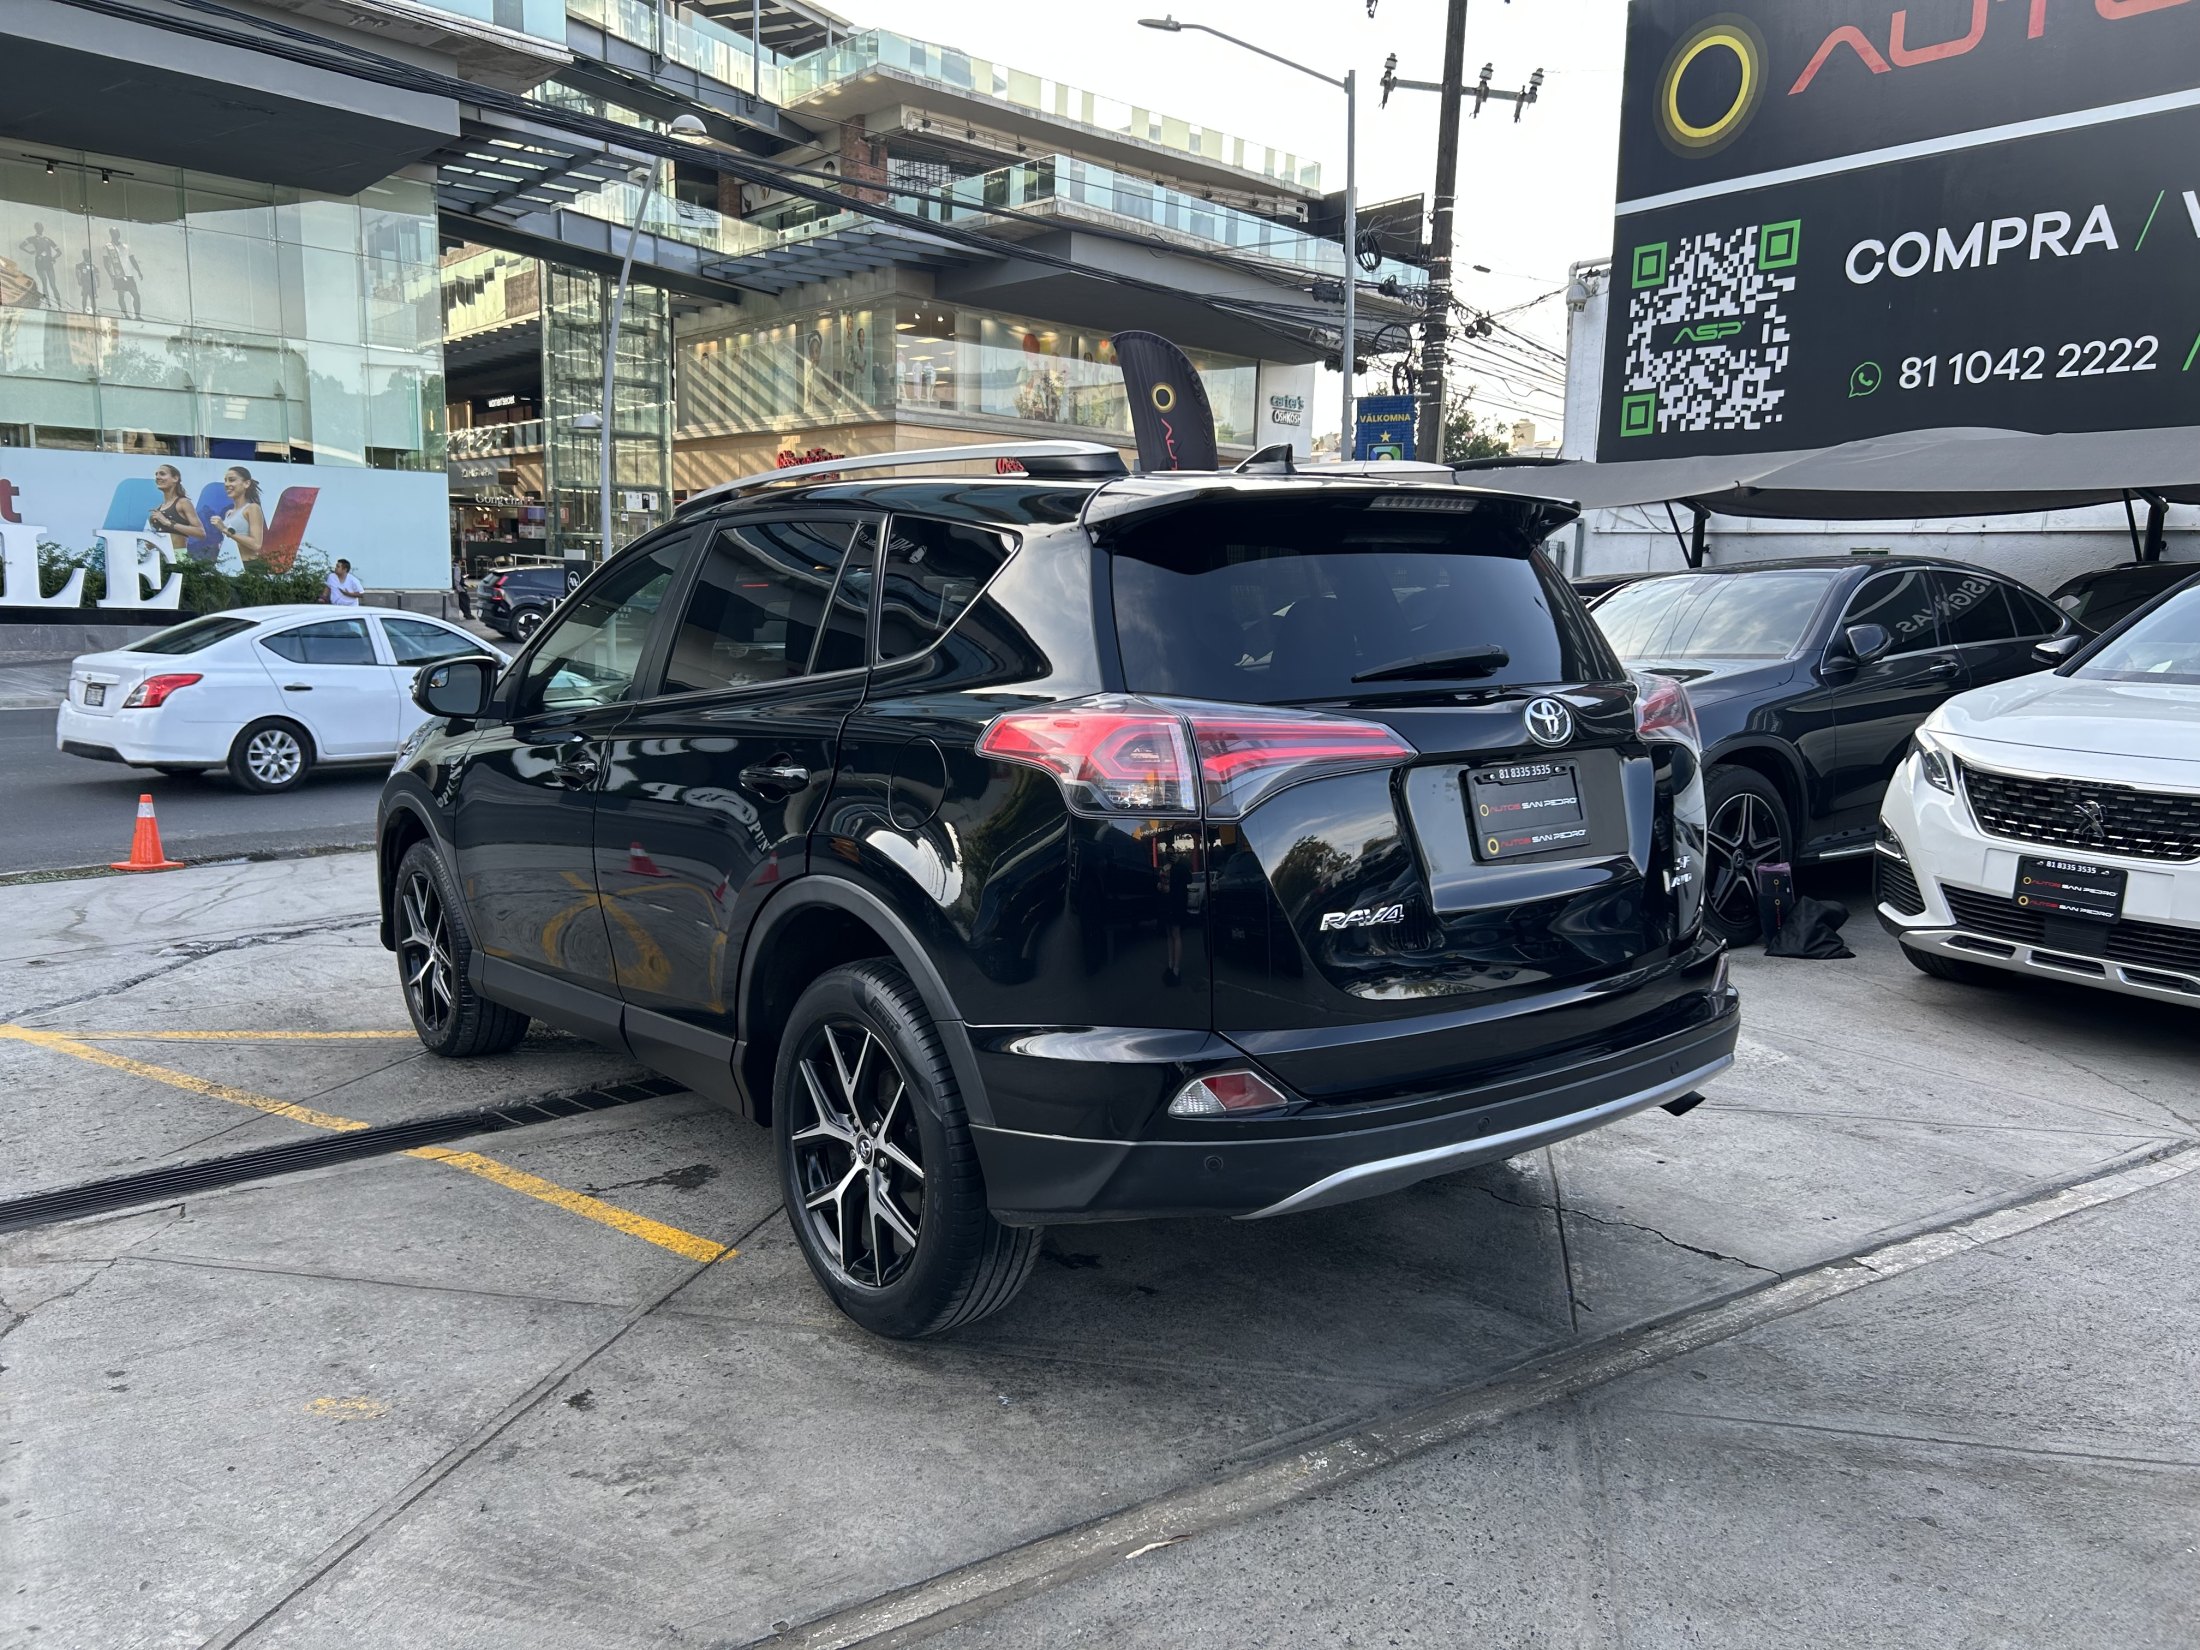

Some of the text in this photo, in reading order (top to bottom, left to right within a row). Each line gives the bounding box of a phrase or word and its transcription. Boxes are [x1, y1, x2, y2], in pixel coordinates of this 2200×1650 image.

[1845, 204, 2119, 285] COMPRA
[1899, 355, 1937, 389] 81
[1948, 346, 2045, 386] 1042
[2056, 335, 2159, 378] 2222
[1360, 413, 1411, 423] VÄLKOMNA
[1499, 764, 1551, 779] 81 8335 3535
[1521, 801, 1543, 809] SAN
[1544, 797, 1577, 807] PEDRO
[1532, 834, 1553, 843] SAN
[1553, 829, 1586, 840] PEDRO
[2046, 860, 2096, 874] 81 8335 3535
[2061, 884, 2082, 892] SAN
[2082, 887, 2118, 897] PEDRO
[2059, 904, 2079, 912] SAN
[1320, 904, 1404, 931] RAV4
